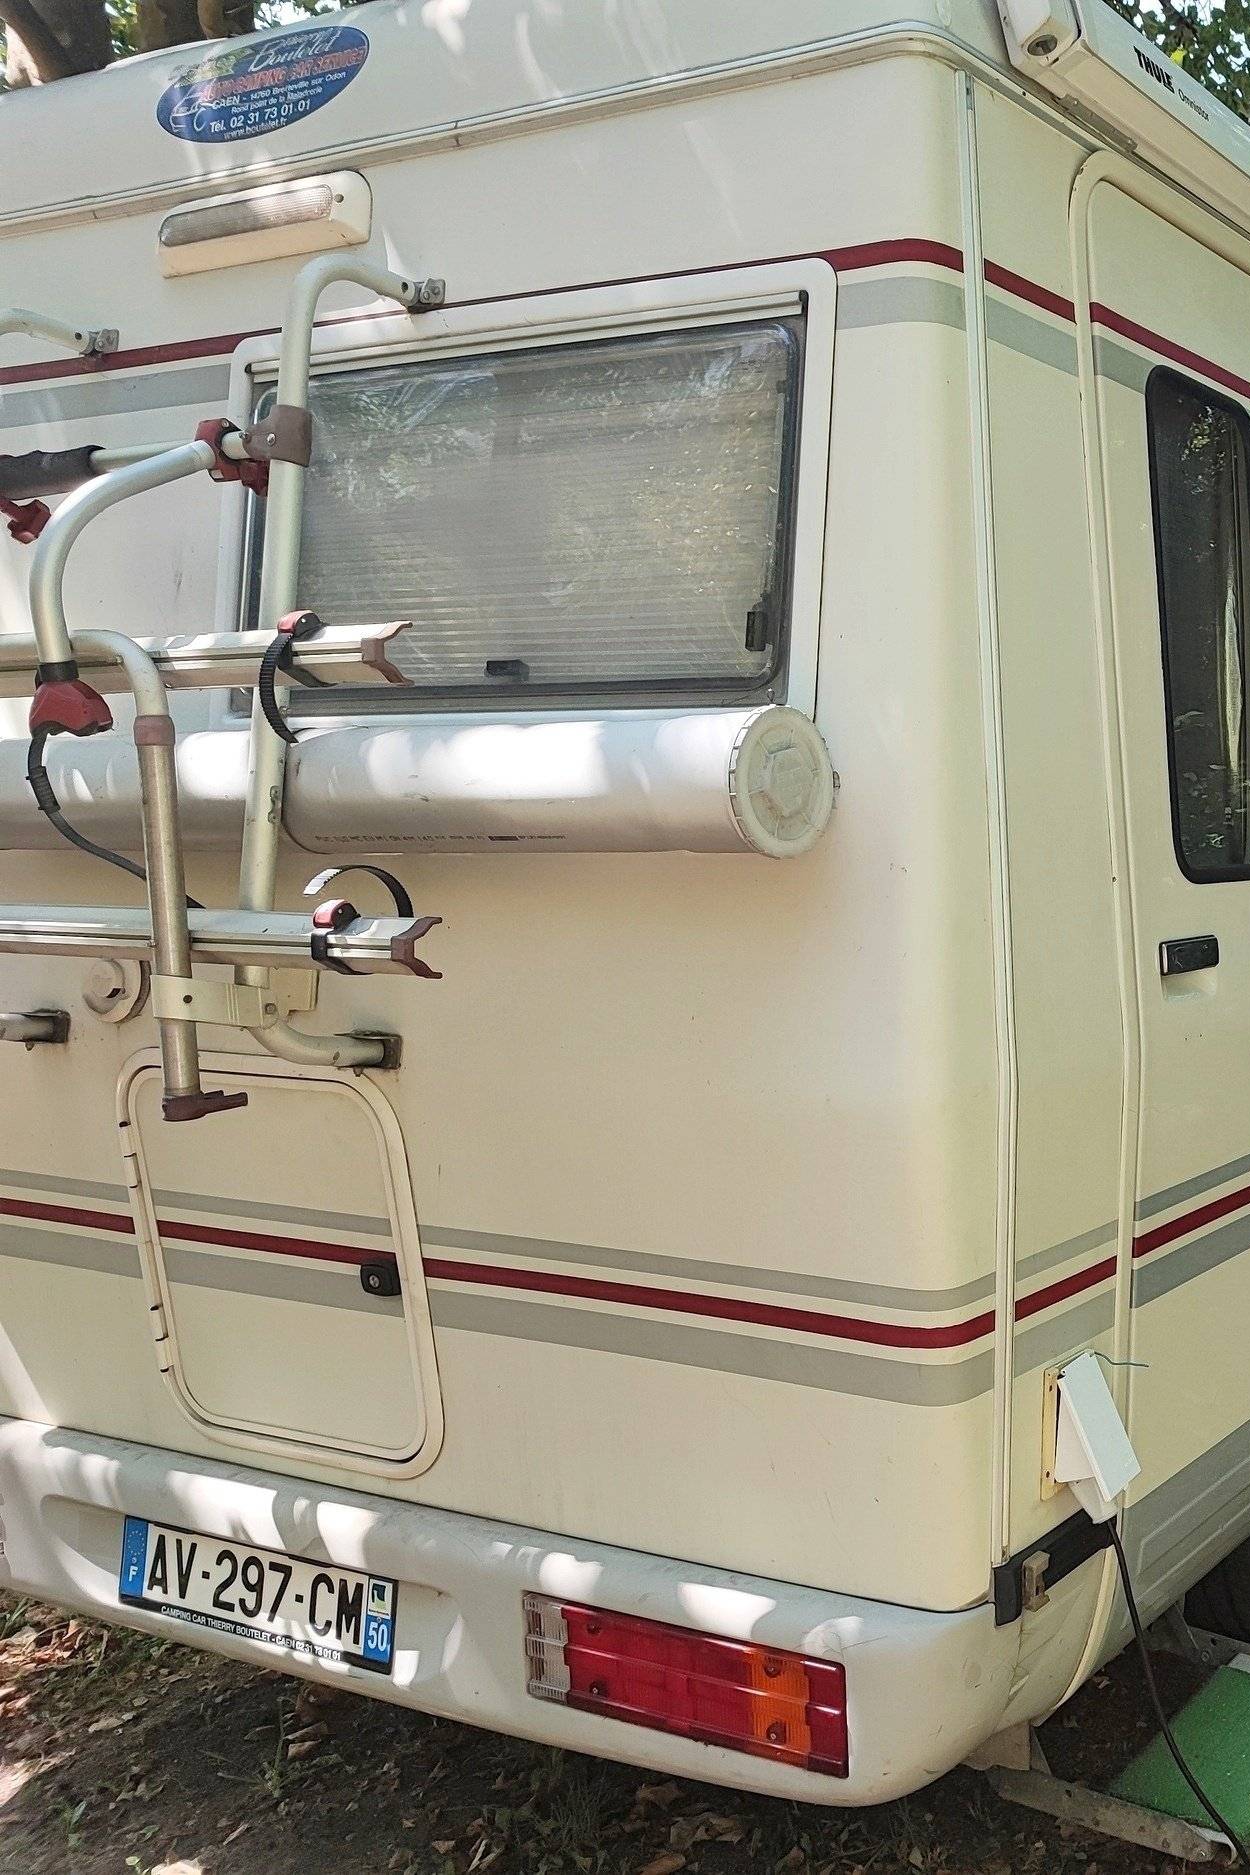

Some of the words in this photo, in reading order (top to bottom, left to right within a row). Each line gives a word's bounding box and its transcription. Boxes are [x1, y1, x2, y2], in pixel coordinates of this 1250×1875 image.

[1133, 45, 1175, 94] THULE
[212, 95, 240, 110] CAEN
[250, 89, 271, 102] 14760
[311, 77, 323, 87] sur
[325, 71, 347, 84] Odon
[230, 116, 244, 129] 02
[247, 112, 260, 125] 31
[264, 108, 278, 121] 73
[128, 1566, 139, 1584] F
[147, 1534, 365, 1646] AV-297-CM
[161, 1606, 191, 1621] CAMPING
[192, 1613, 207, 1626] CAR
[207, 1617, 236, 1632] THIERRY
[236, 1626, 271, 1642] BOUTELET
[276, 1636, 295, 1649] CAEN
[296, 1640, 304, 1652] 02
[304, 1642, 313, 1653] 31
[332, 1650, 341, 1661] 01
[367, 1621, 388, 1652] 50
